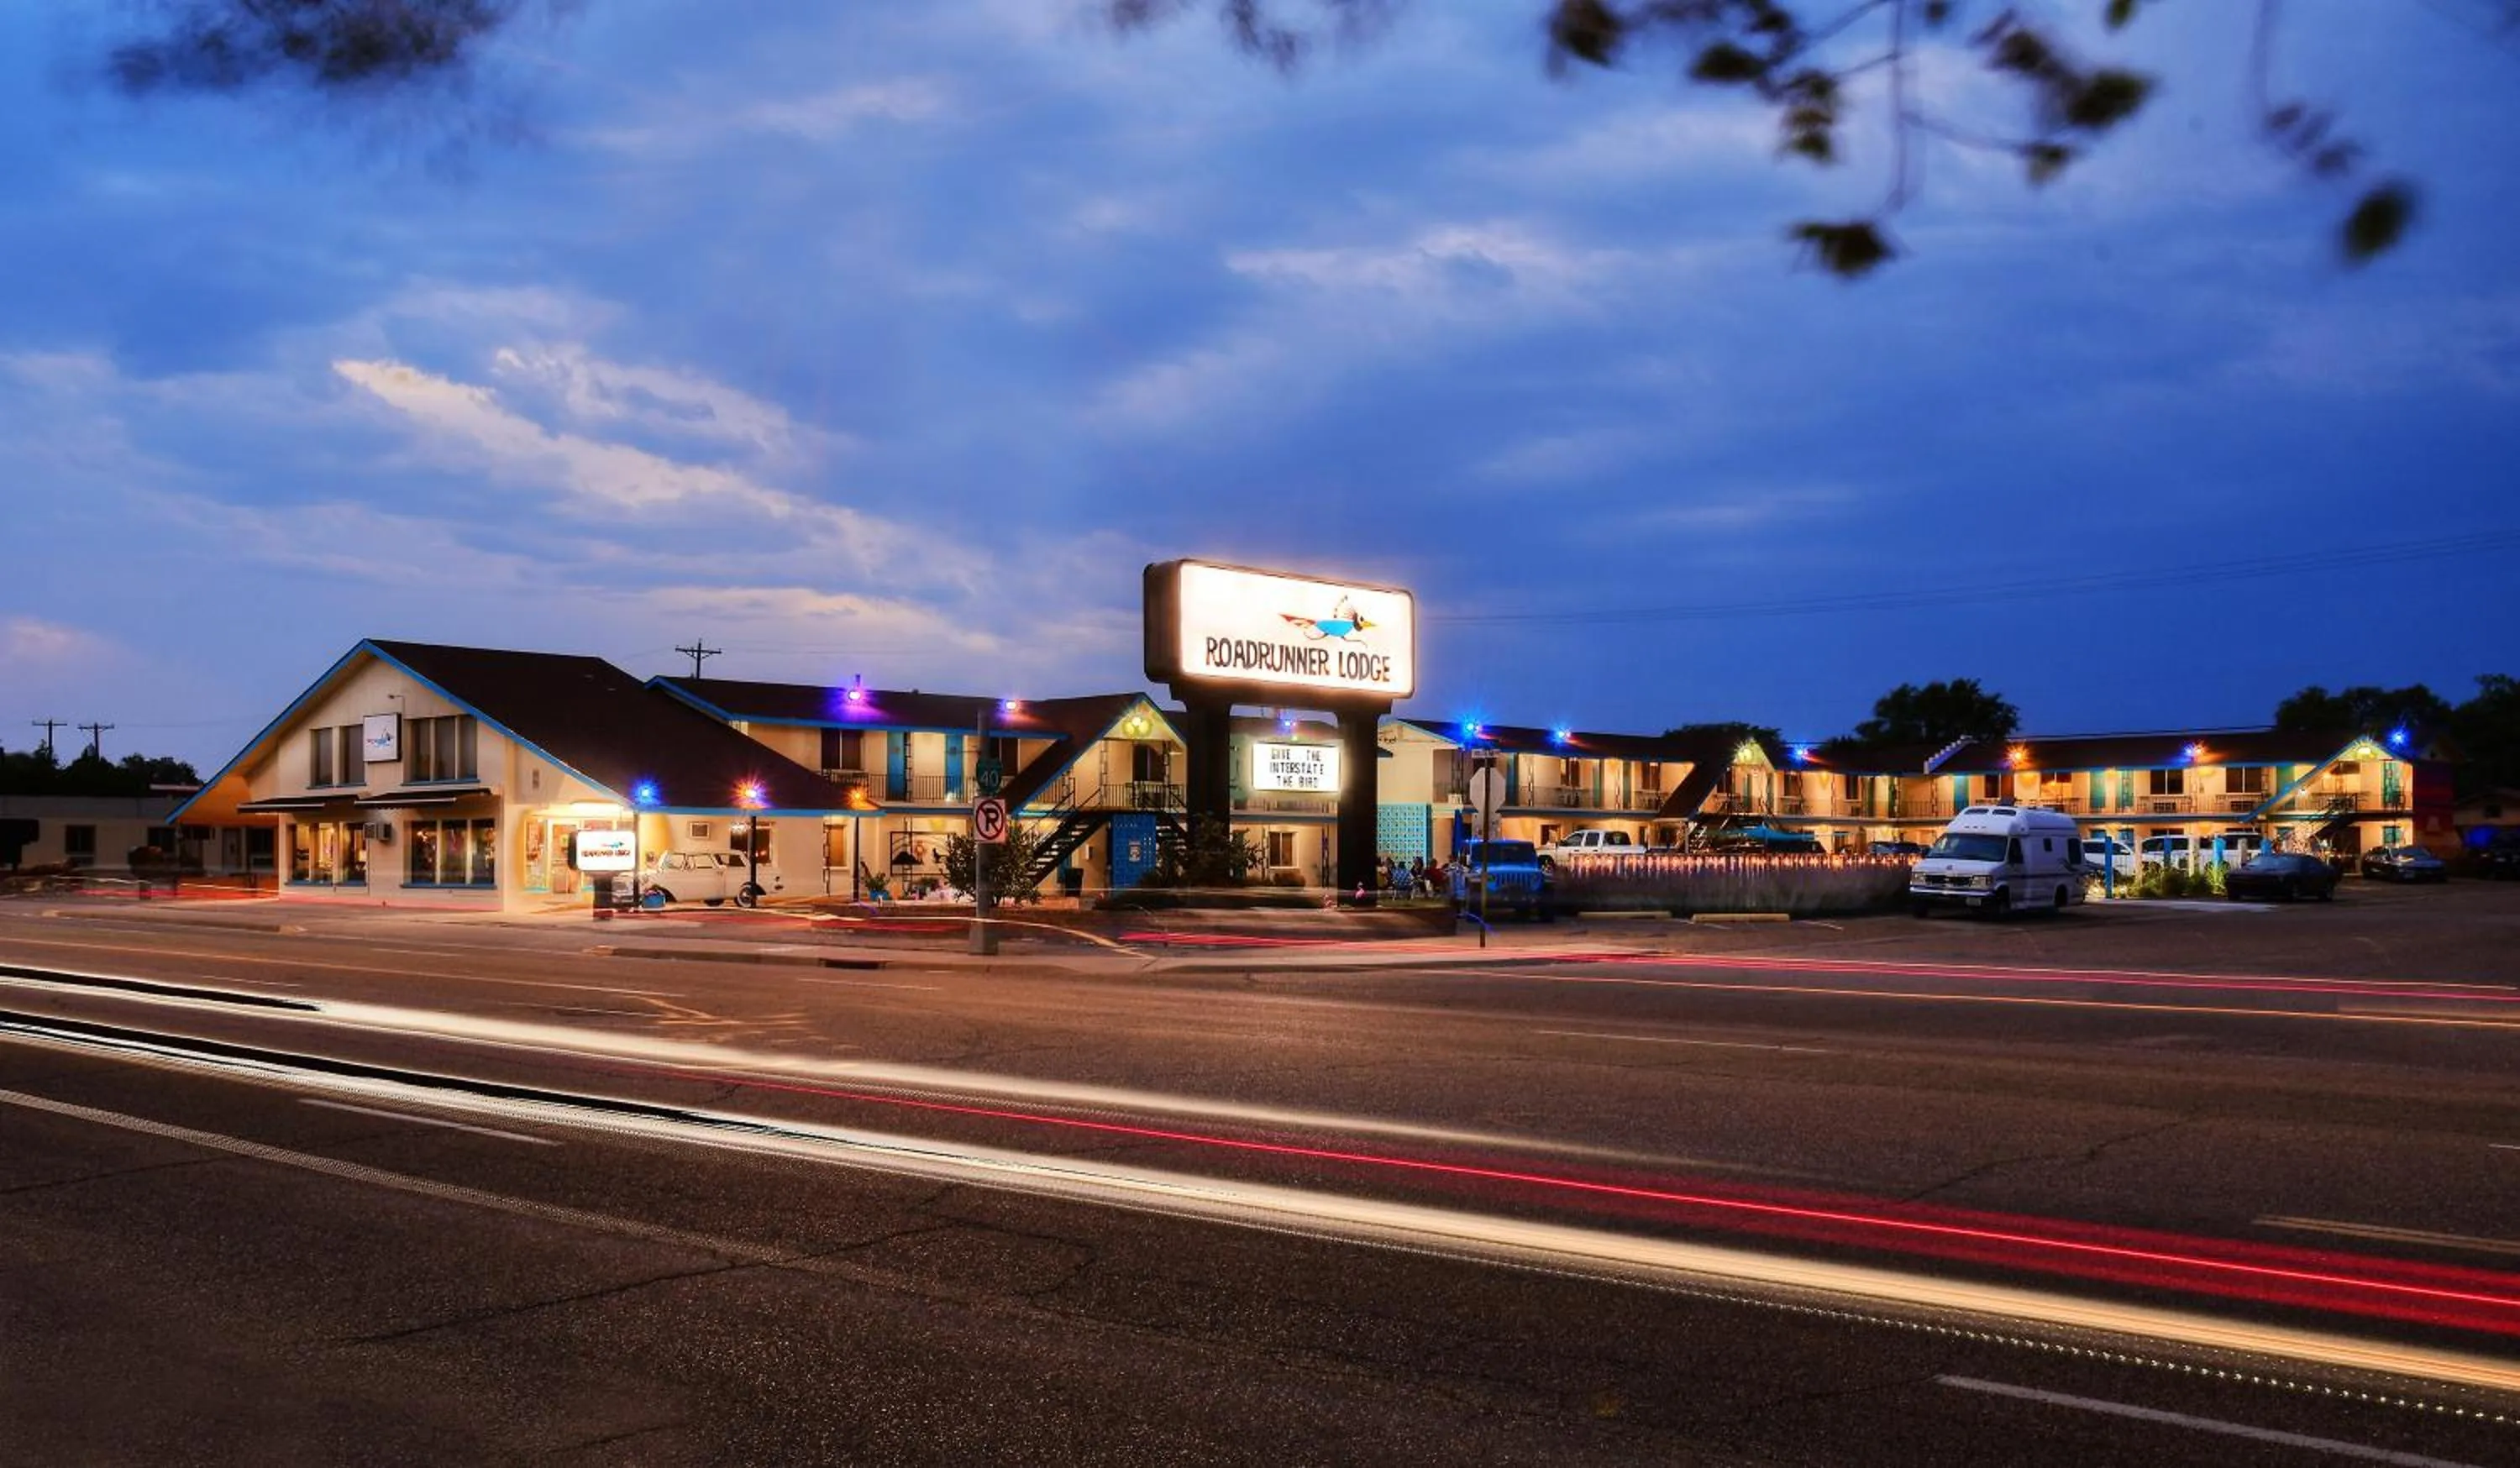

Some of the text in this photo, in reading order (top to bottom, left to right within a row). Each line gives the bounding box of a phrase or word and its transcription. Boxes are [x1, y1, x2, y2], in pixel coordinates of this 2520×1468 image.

[1205, 637, 1390, 682] ROADRUNNER LODGE
[1307, 749, 1321, 762] THE
[1269, 762, 1325, 774] INTERSTATE
[980, 770, 999, 787] 40
[1276, 775, 1318, 789] THE BIRD
[985, 808, 1000, 831] P
